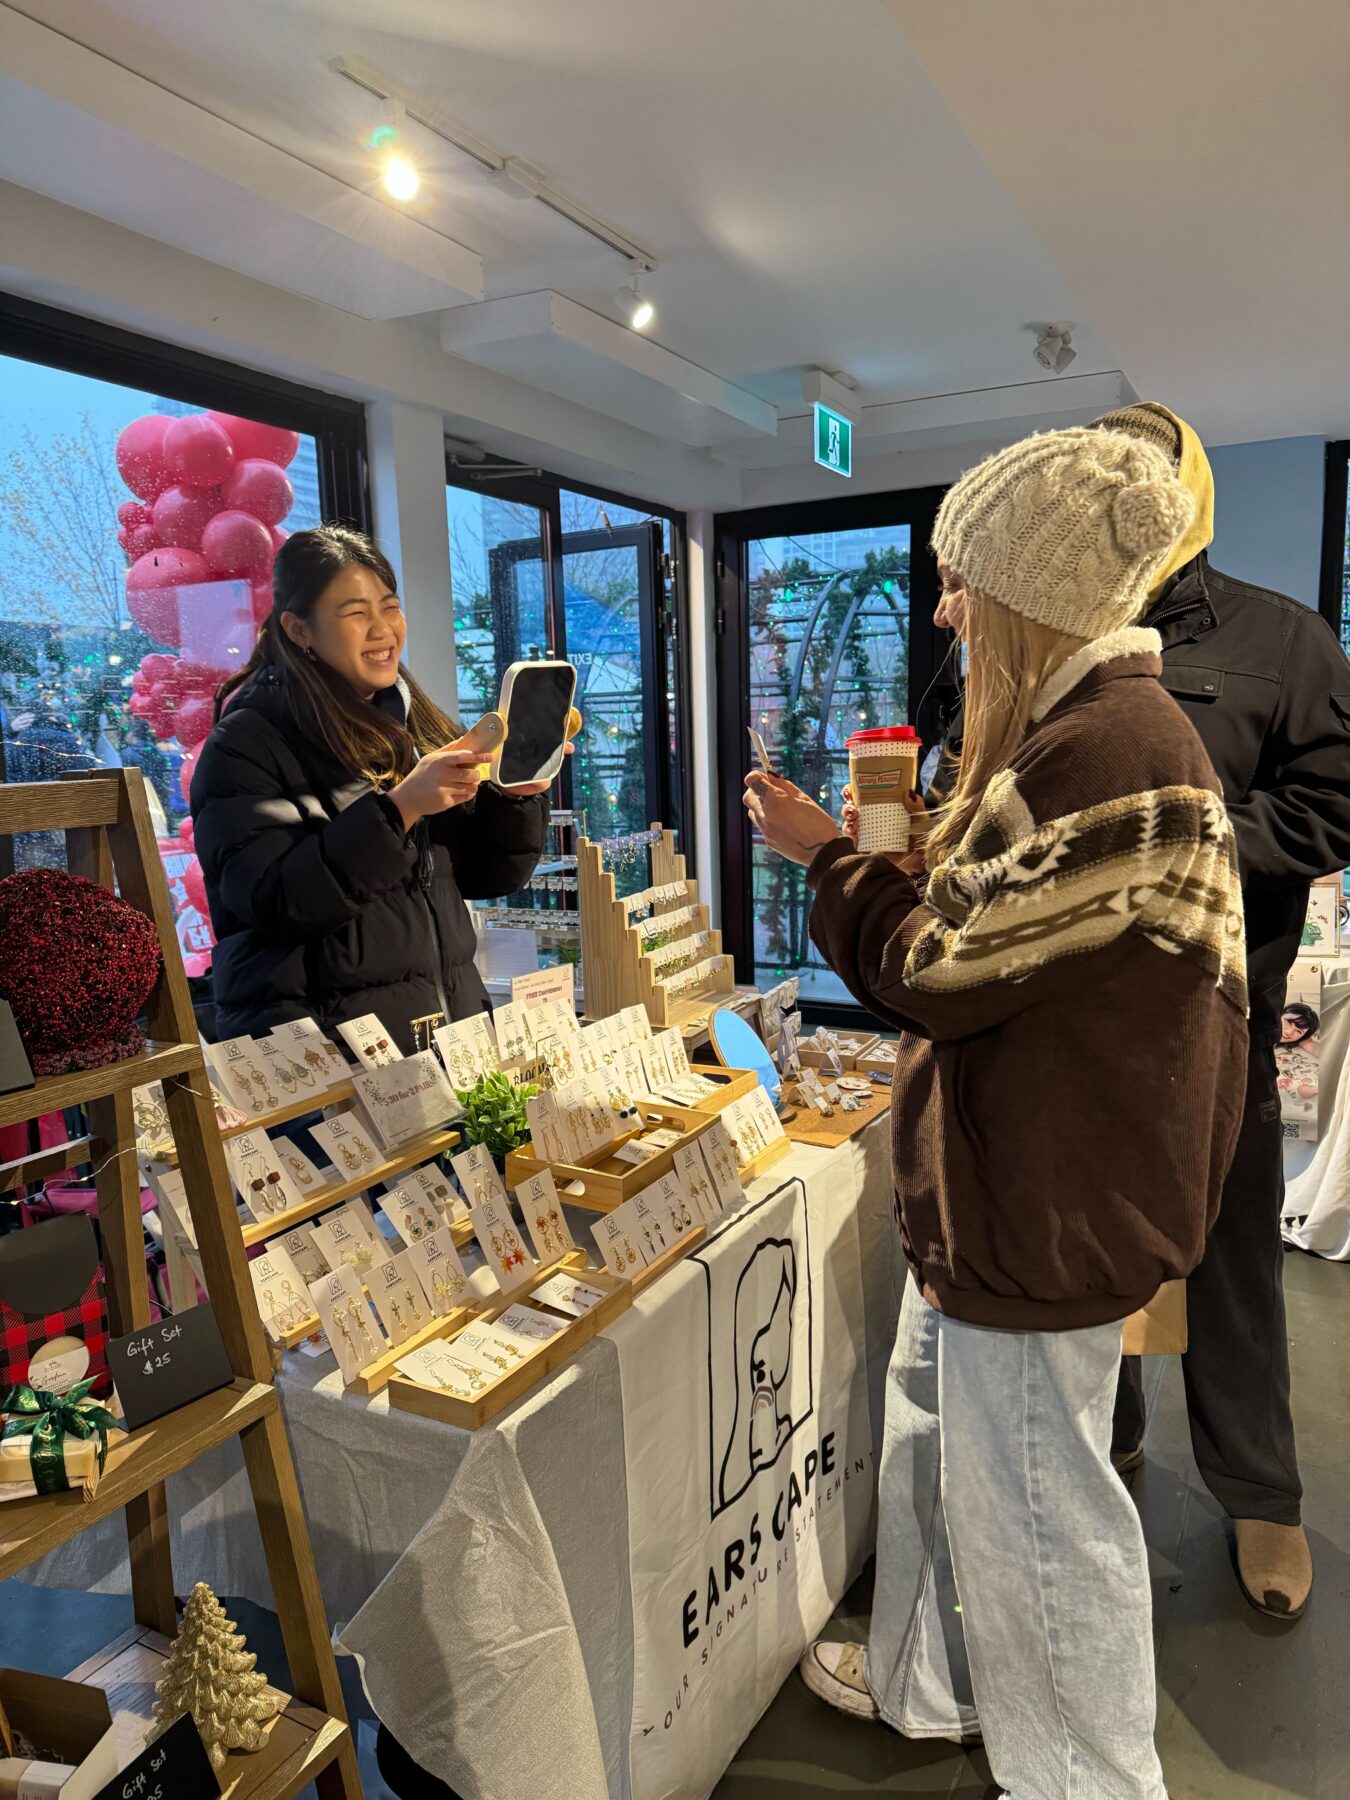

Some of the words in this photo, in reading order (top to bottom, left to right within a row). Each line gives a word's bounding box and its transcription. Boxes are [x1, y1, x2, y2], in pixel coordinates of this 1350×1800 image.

[127, 1338, 154, 1357] Gift
[161, 1324, 182, 1342] Set
[142, 1352, 171, 1375] $25
[643, 1673, 690, 1737] YOUR
[701, 1547, 789, 1666] SIGNATURE
[122, 1772, 147, 1799] Gift
[150, 1749, 166, 1772] Set
